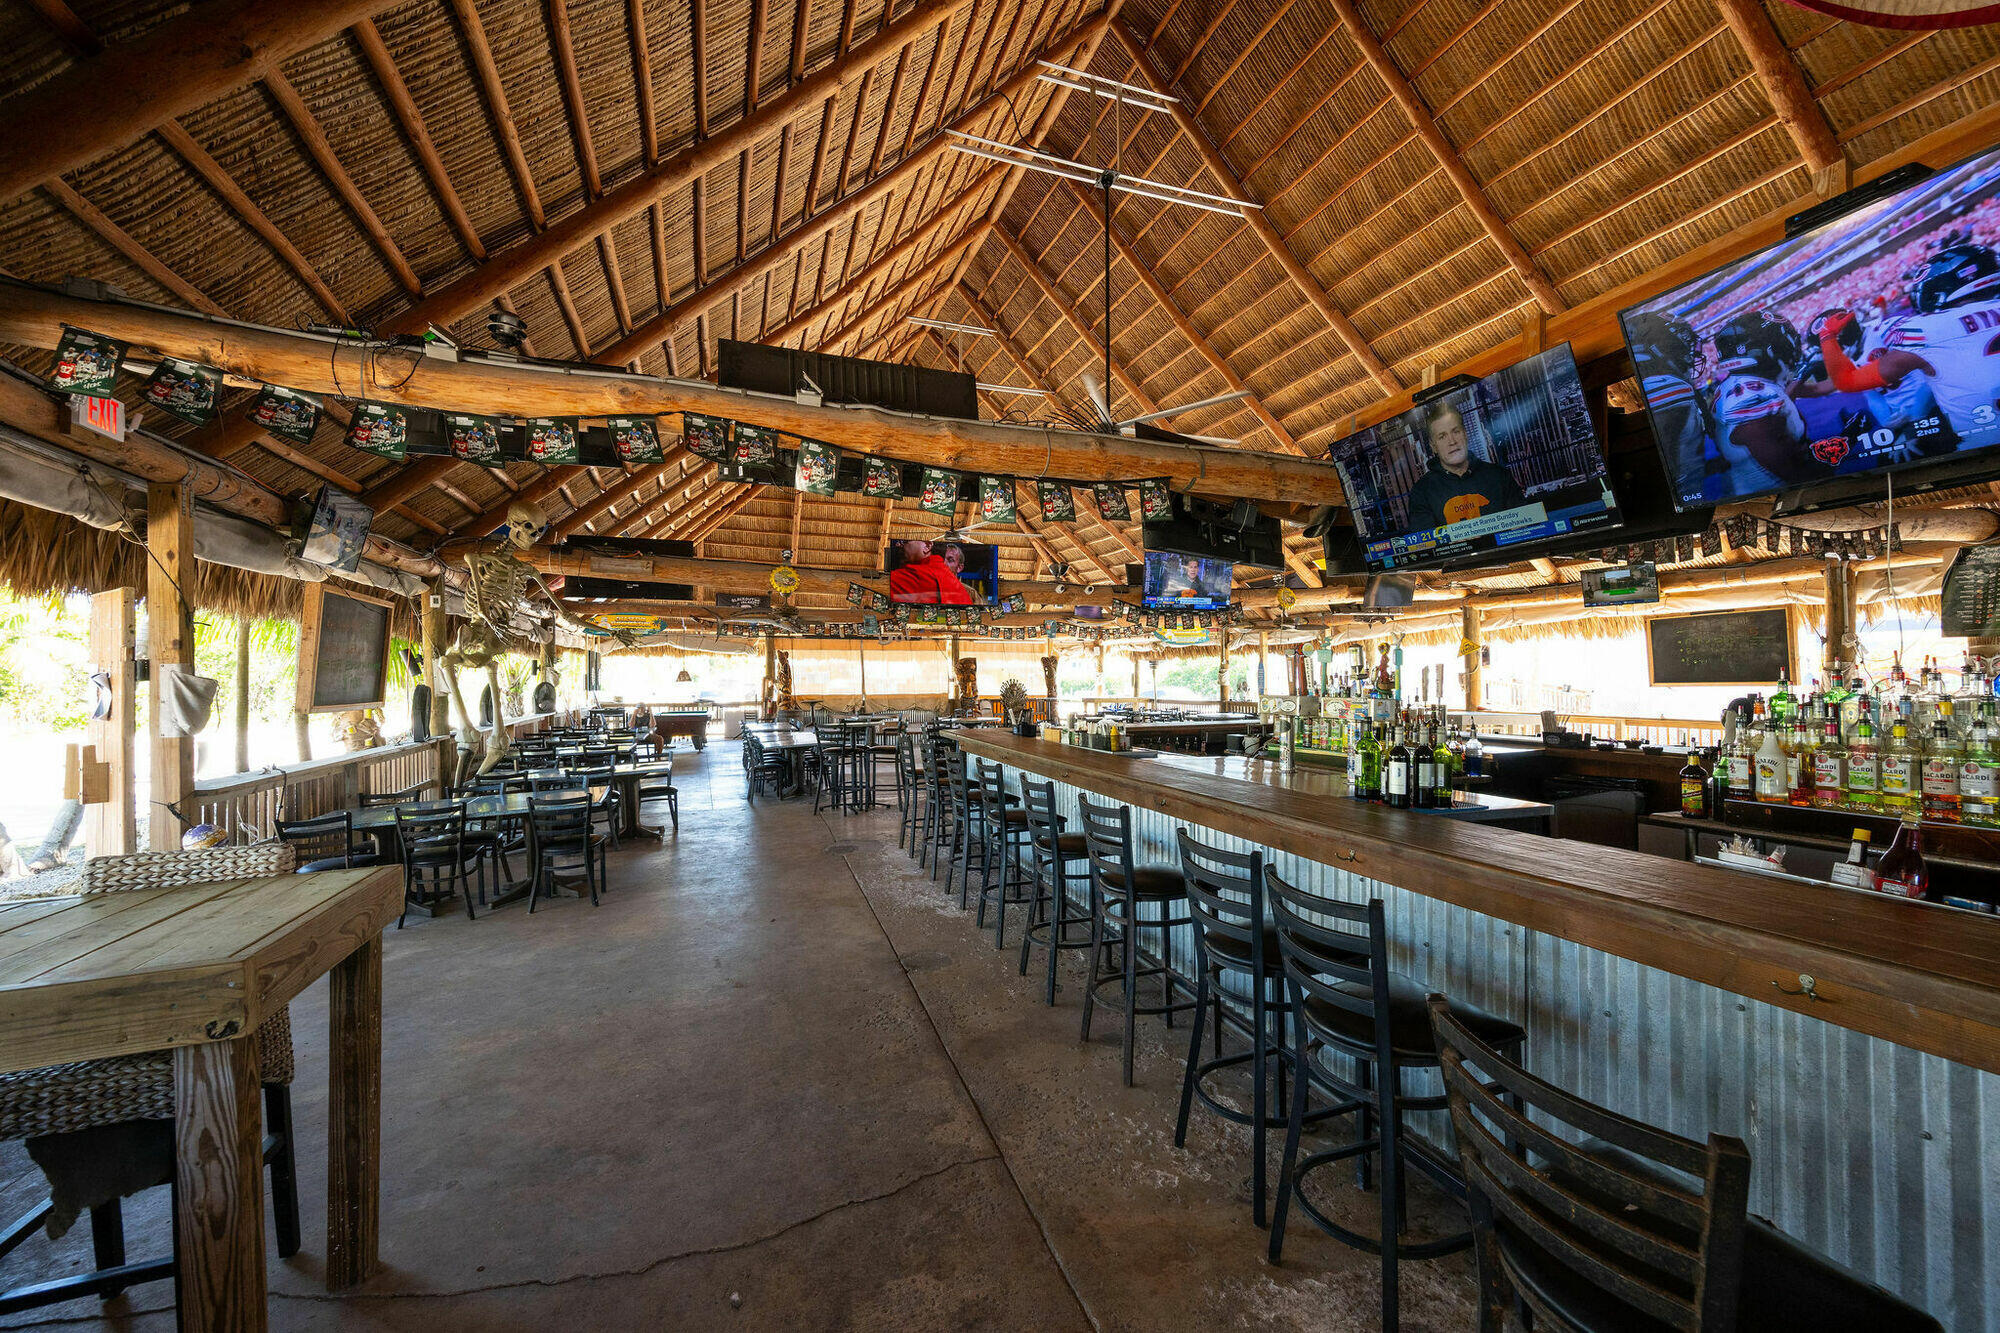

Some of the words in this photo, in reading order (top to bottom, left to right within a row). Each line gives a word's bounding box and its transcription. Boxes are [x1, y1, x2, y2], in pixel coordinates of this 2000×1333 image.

[88, 396, 119, 434] EXIT
[1972, 405, 1996, 424] 3
[1914, 417, 1940, 428] :35
[1916, 427, 1940, 437] 2ND
[1857, 428, 1894, 450] 10
[1683, 492, 1702, 502] 0:45
[1454, 503, 1475, 513] DOWN
[1451, 522, 1472, 532] Looking
[1497, 512, 1519, 521] Sunday
[1500, 517, 1532, 528] Seahawks
[1408, 535, 1418, 545] 19
[1420, 531, 1432, 541] 21
